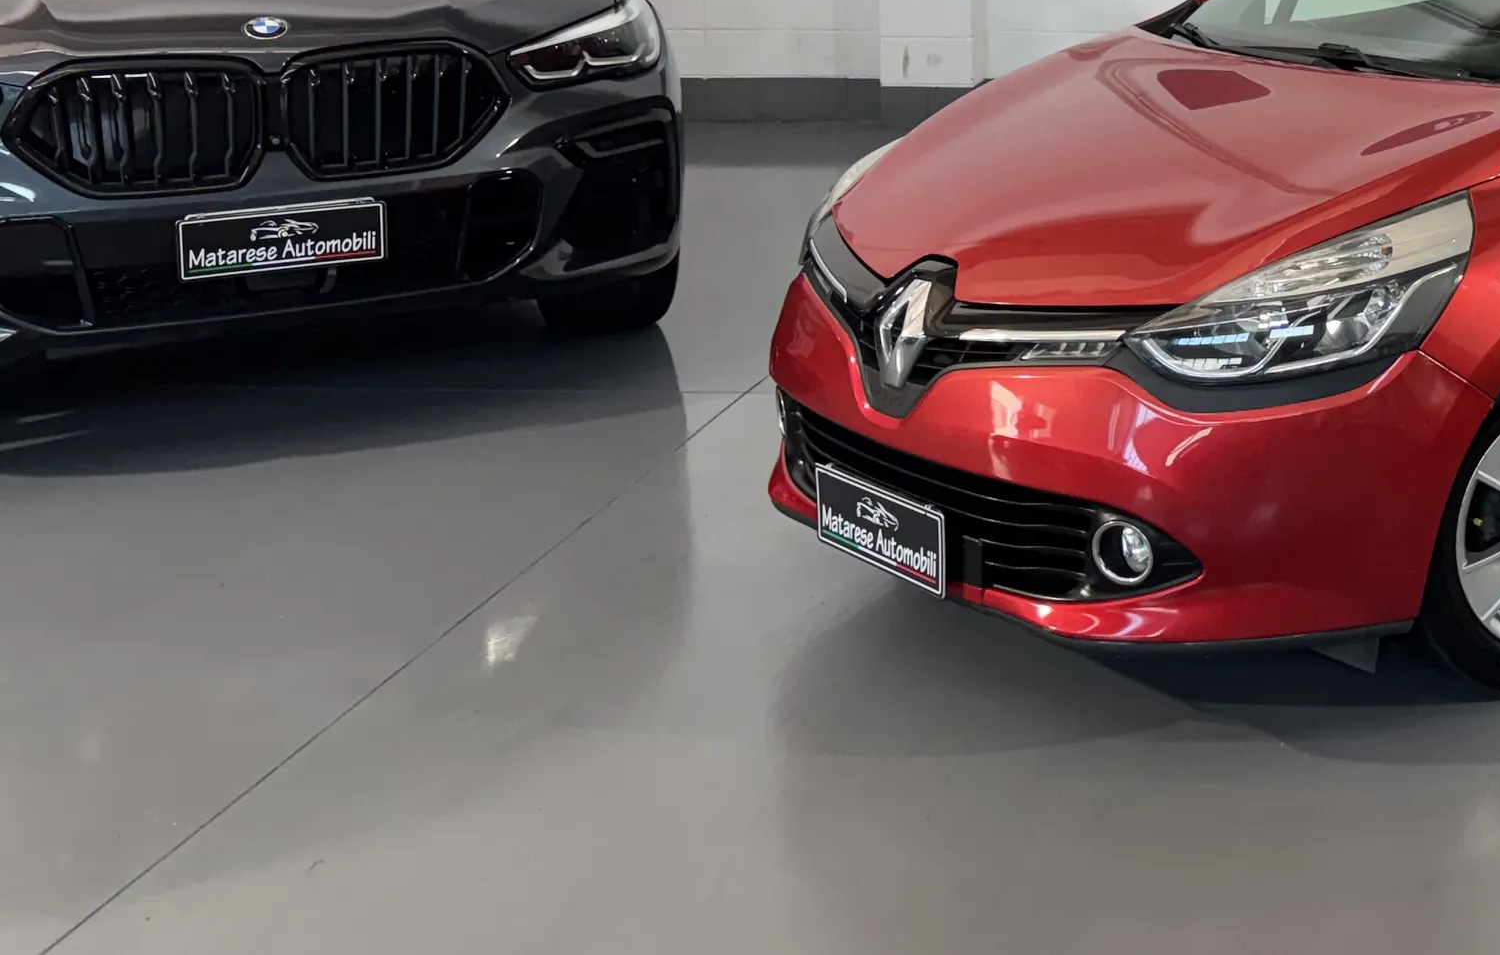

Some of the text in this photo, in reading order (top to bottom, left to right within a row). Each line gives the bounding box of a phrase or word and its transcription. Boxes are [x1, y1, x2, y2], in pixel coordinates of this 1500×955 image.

[189, 231, 377, 269] Matarese Automobili
[822, 504, 937, 577] Matarese Automobili
